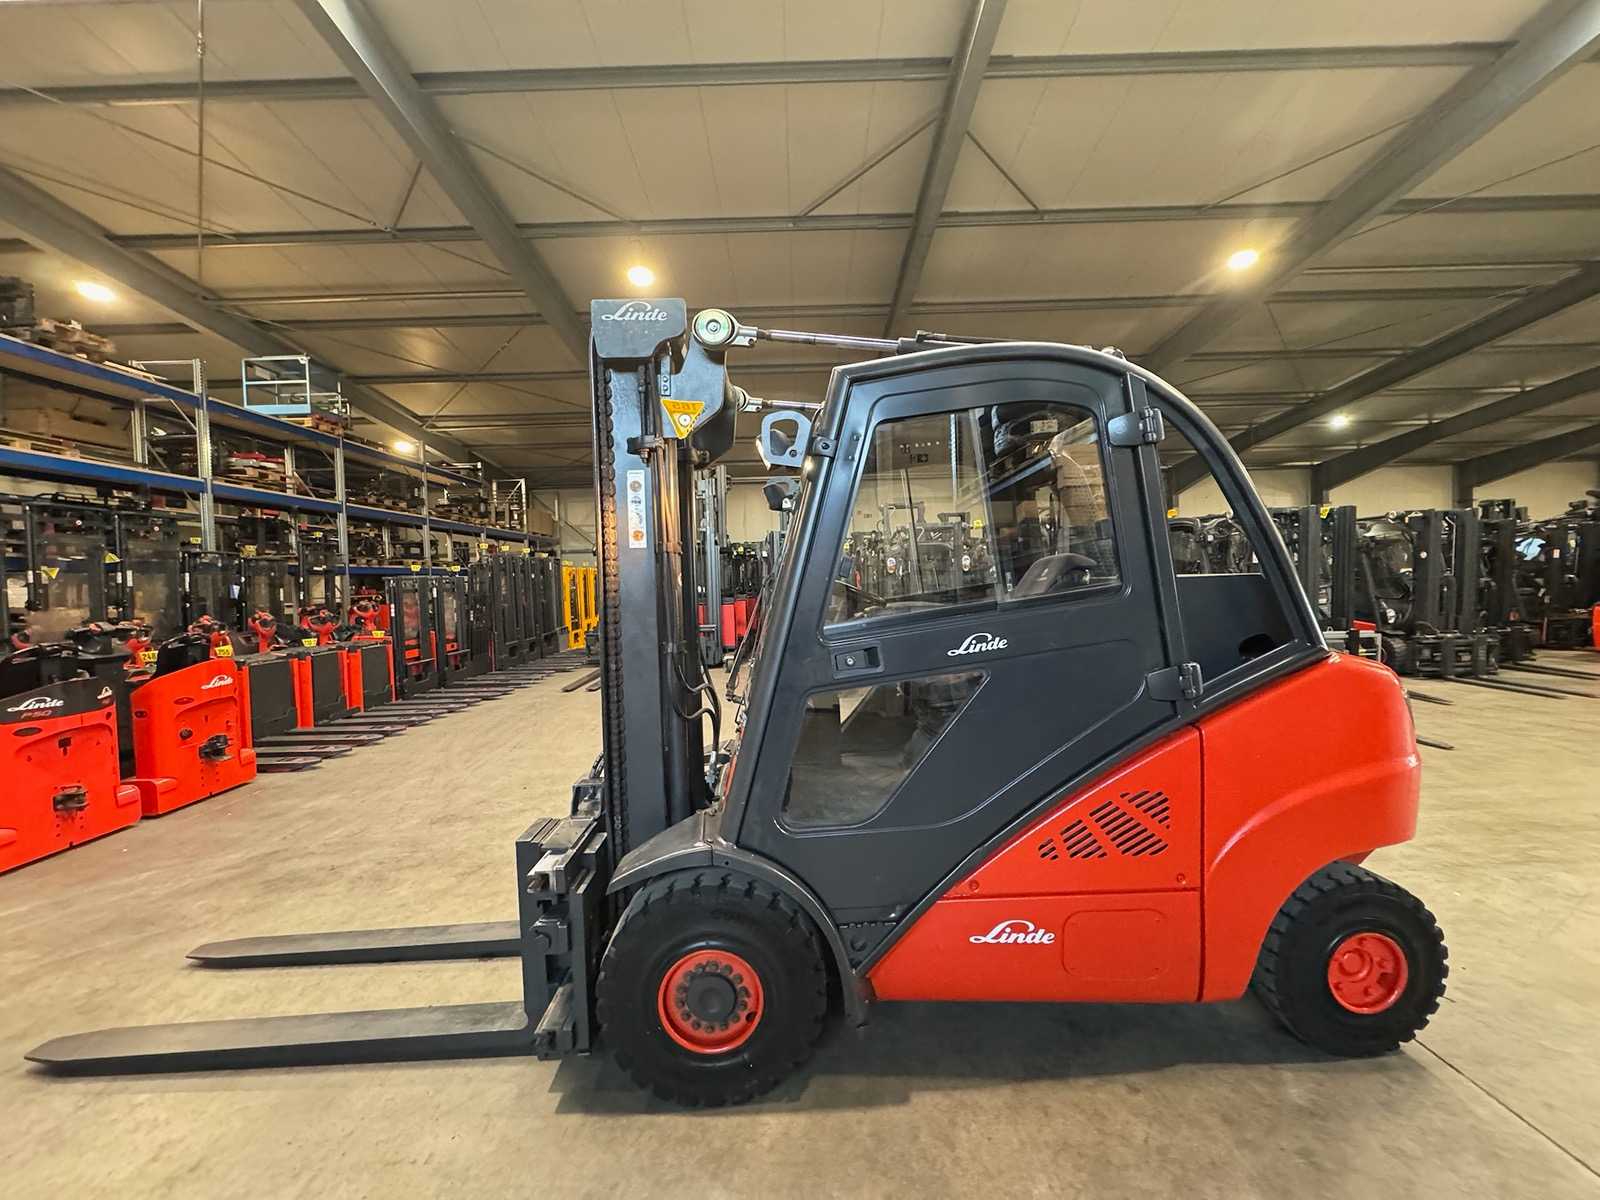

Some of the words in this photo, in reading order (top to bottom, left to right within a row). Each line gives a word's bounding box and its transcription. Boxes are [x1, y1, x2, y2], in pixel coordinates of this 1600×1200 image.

[600, 300, 669, 321] Linde
[947, 632, 1008, 657] Linde
[201, 674, 233, 690] Linde
[7, 697, 64, 713] Linde
[969, 919, 1056, 945] Linde
